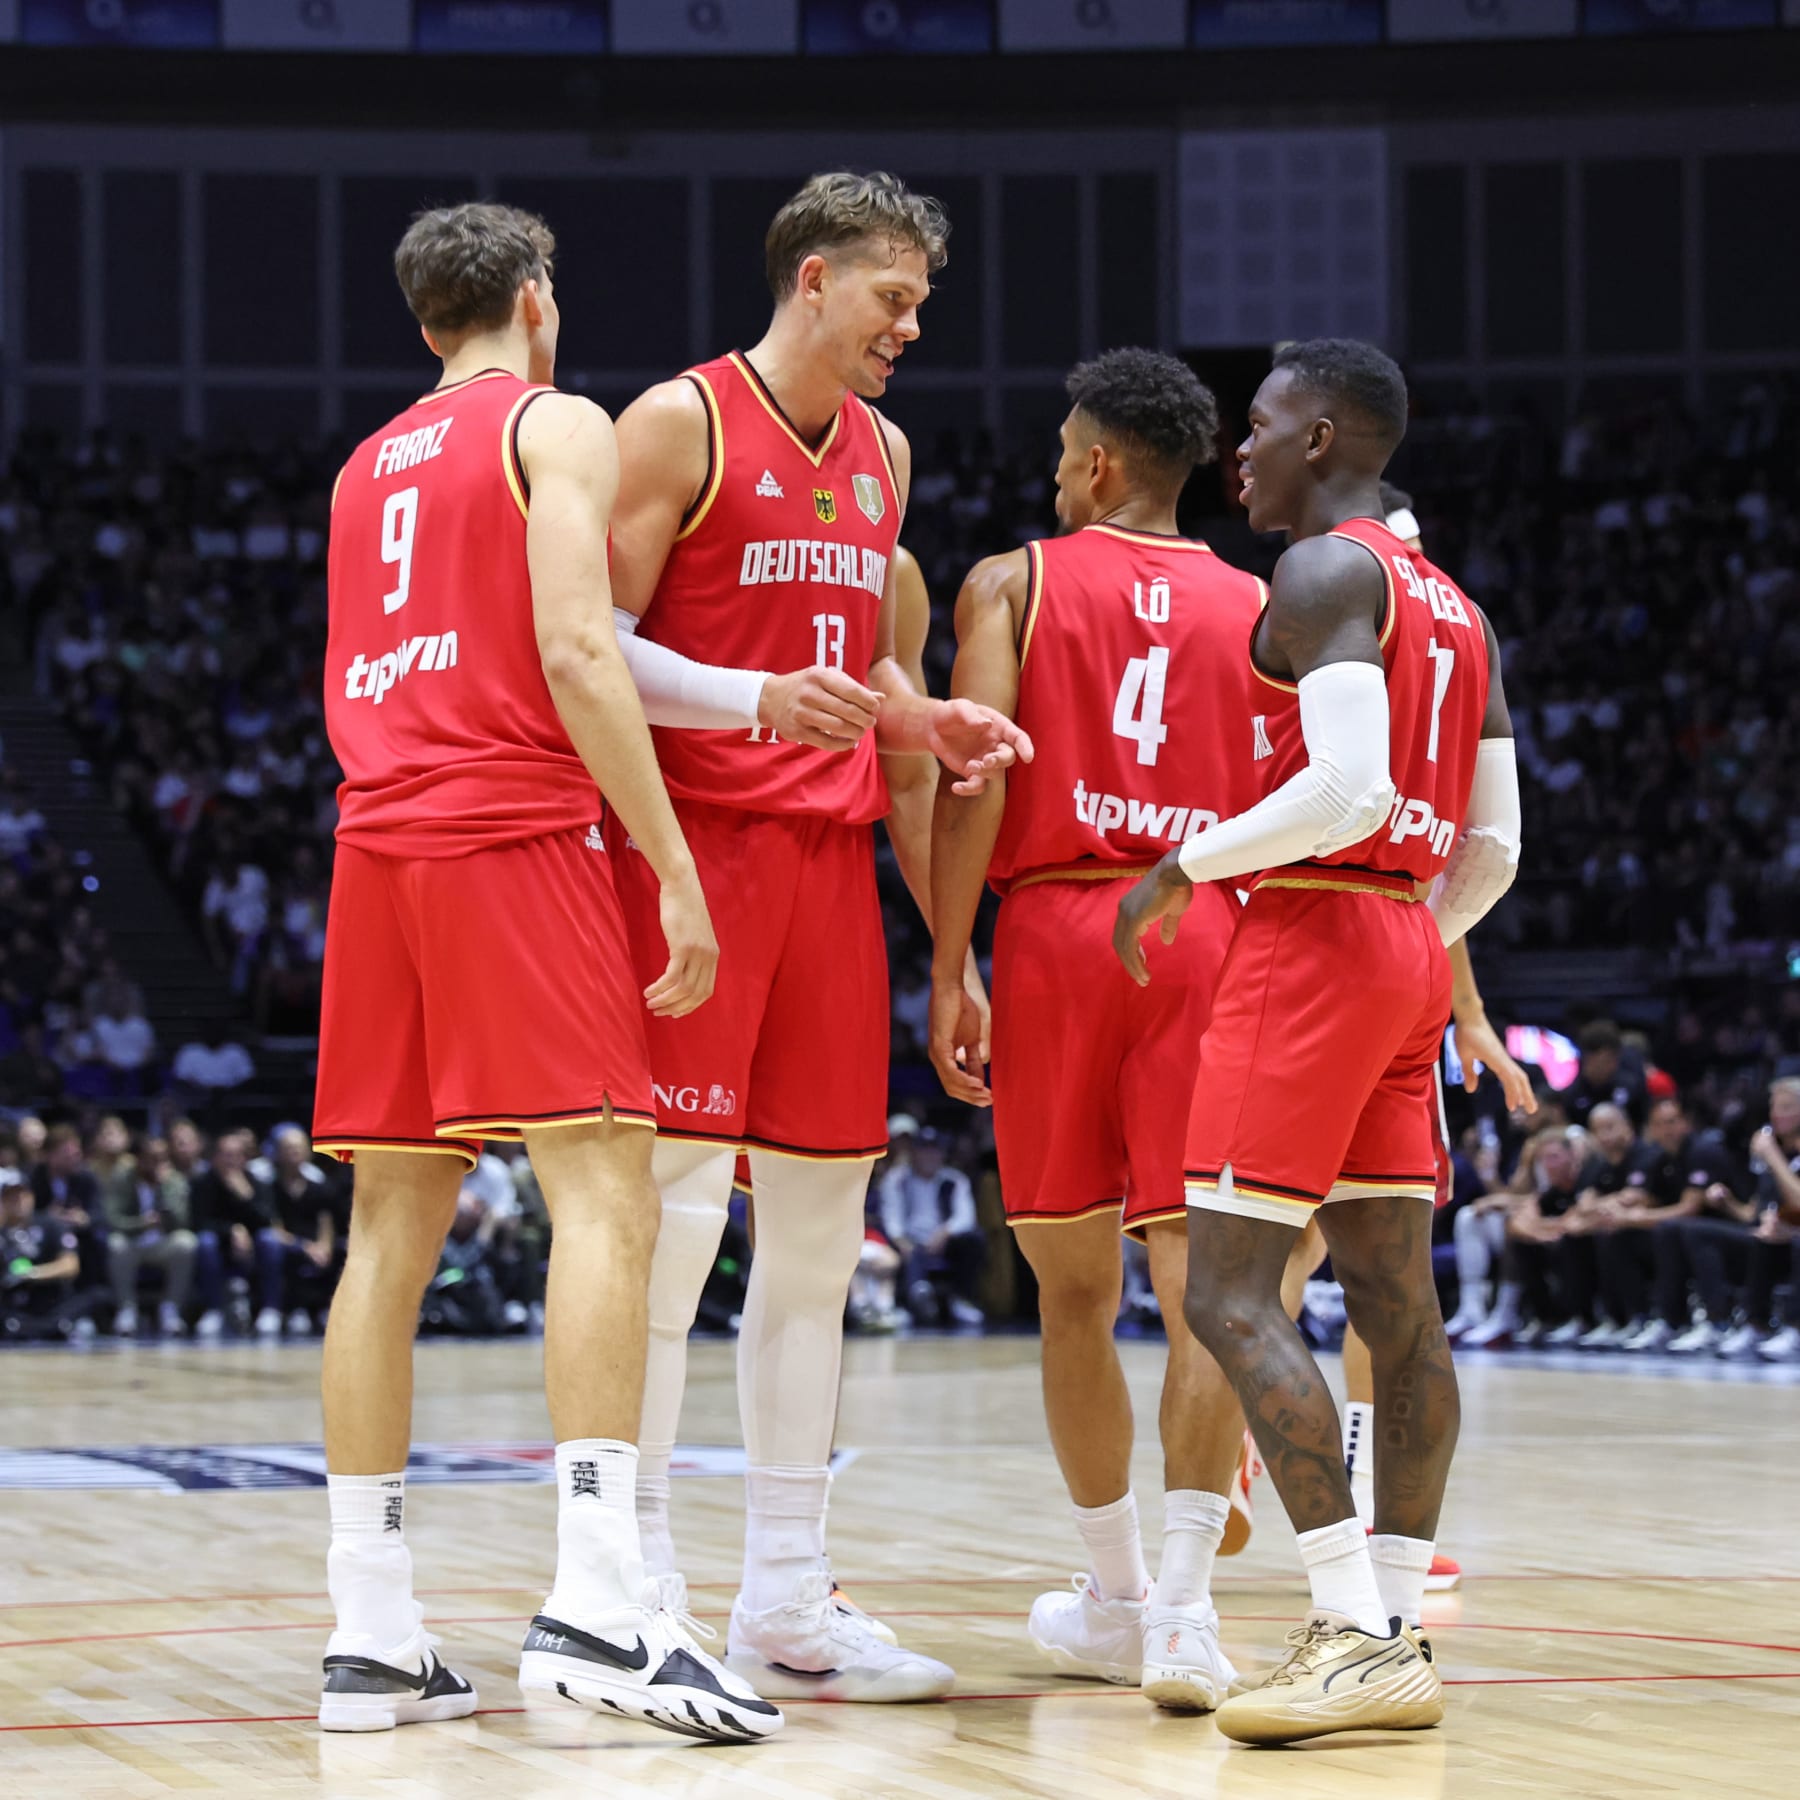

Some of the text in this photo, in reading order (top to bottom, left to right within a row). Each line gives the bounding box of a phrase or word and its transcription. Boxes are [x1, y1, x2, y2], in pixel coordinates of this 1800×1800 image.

[373, 416, 454, 479] FRANZ
[755, 484, 784, 498] PEAK
[381, 487, 419, 616] 9
[1134, 576, 1170, 624] LÔ
[812, 613, 845, 671] 13
[1112, 645, 1170, 767] 4
[1073, 778, 1219, 843] tipwin
[652, 1083, 700, 1112] NG
[569, 1460, 601, 1499] PEAK
[384, 1496, 402, 1533] PEAK
